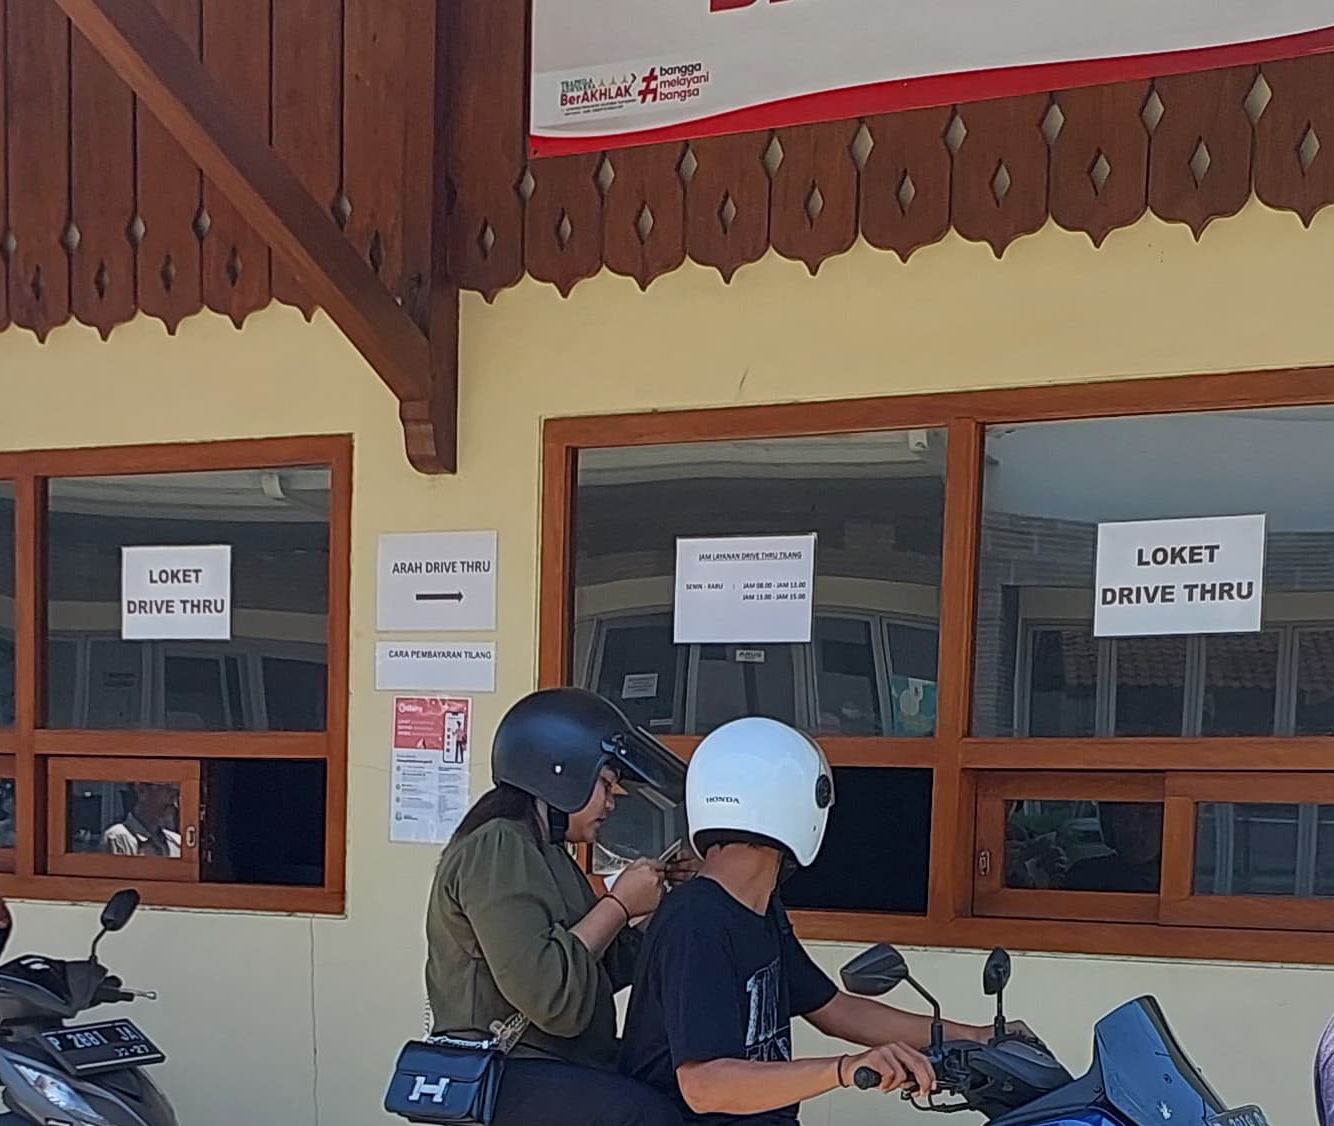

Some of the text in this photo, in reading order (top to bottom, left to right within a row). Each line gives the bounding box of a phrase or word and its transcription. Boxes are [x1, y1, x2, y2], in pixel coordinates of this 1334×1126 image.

[660, 63, 702, 77] bangga
[660, 72, 709, 91] melayani
[560, 85, 632, 106] BerAKHLAK
[660, 88, 700, 102] bangsa
[712, 552, 740, 561] LAYANAN
[741, 552, 760, 560] DRIVE
[761, 551, 778, 560] THRU
[778, 551, 803, 560] TILANG
[1137, 545, 1220, 567] LOKET
[392, 560, 491, 574] ARAH DRIVE THRU
[149, 569, 203, 584] LOKET
[1101, 581, 1254, 605] DRIVE THRU
[127, 599, 225, 614] DRIVE THRU
[389, 650, 492, 660] CARA PEMBAYARAN TILANG
[706, 796, 740, 804] HONDA
[48, 1036, 63, 1052] P
